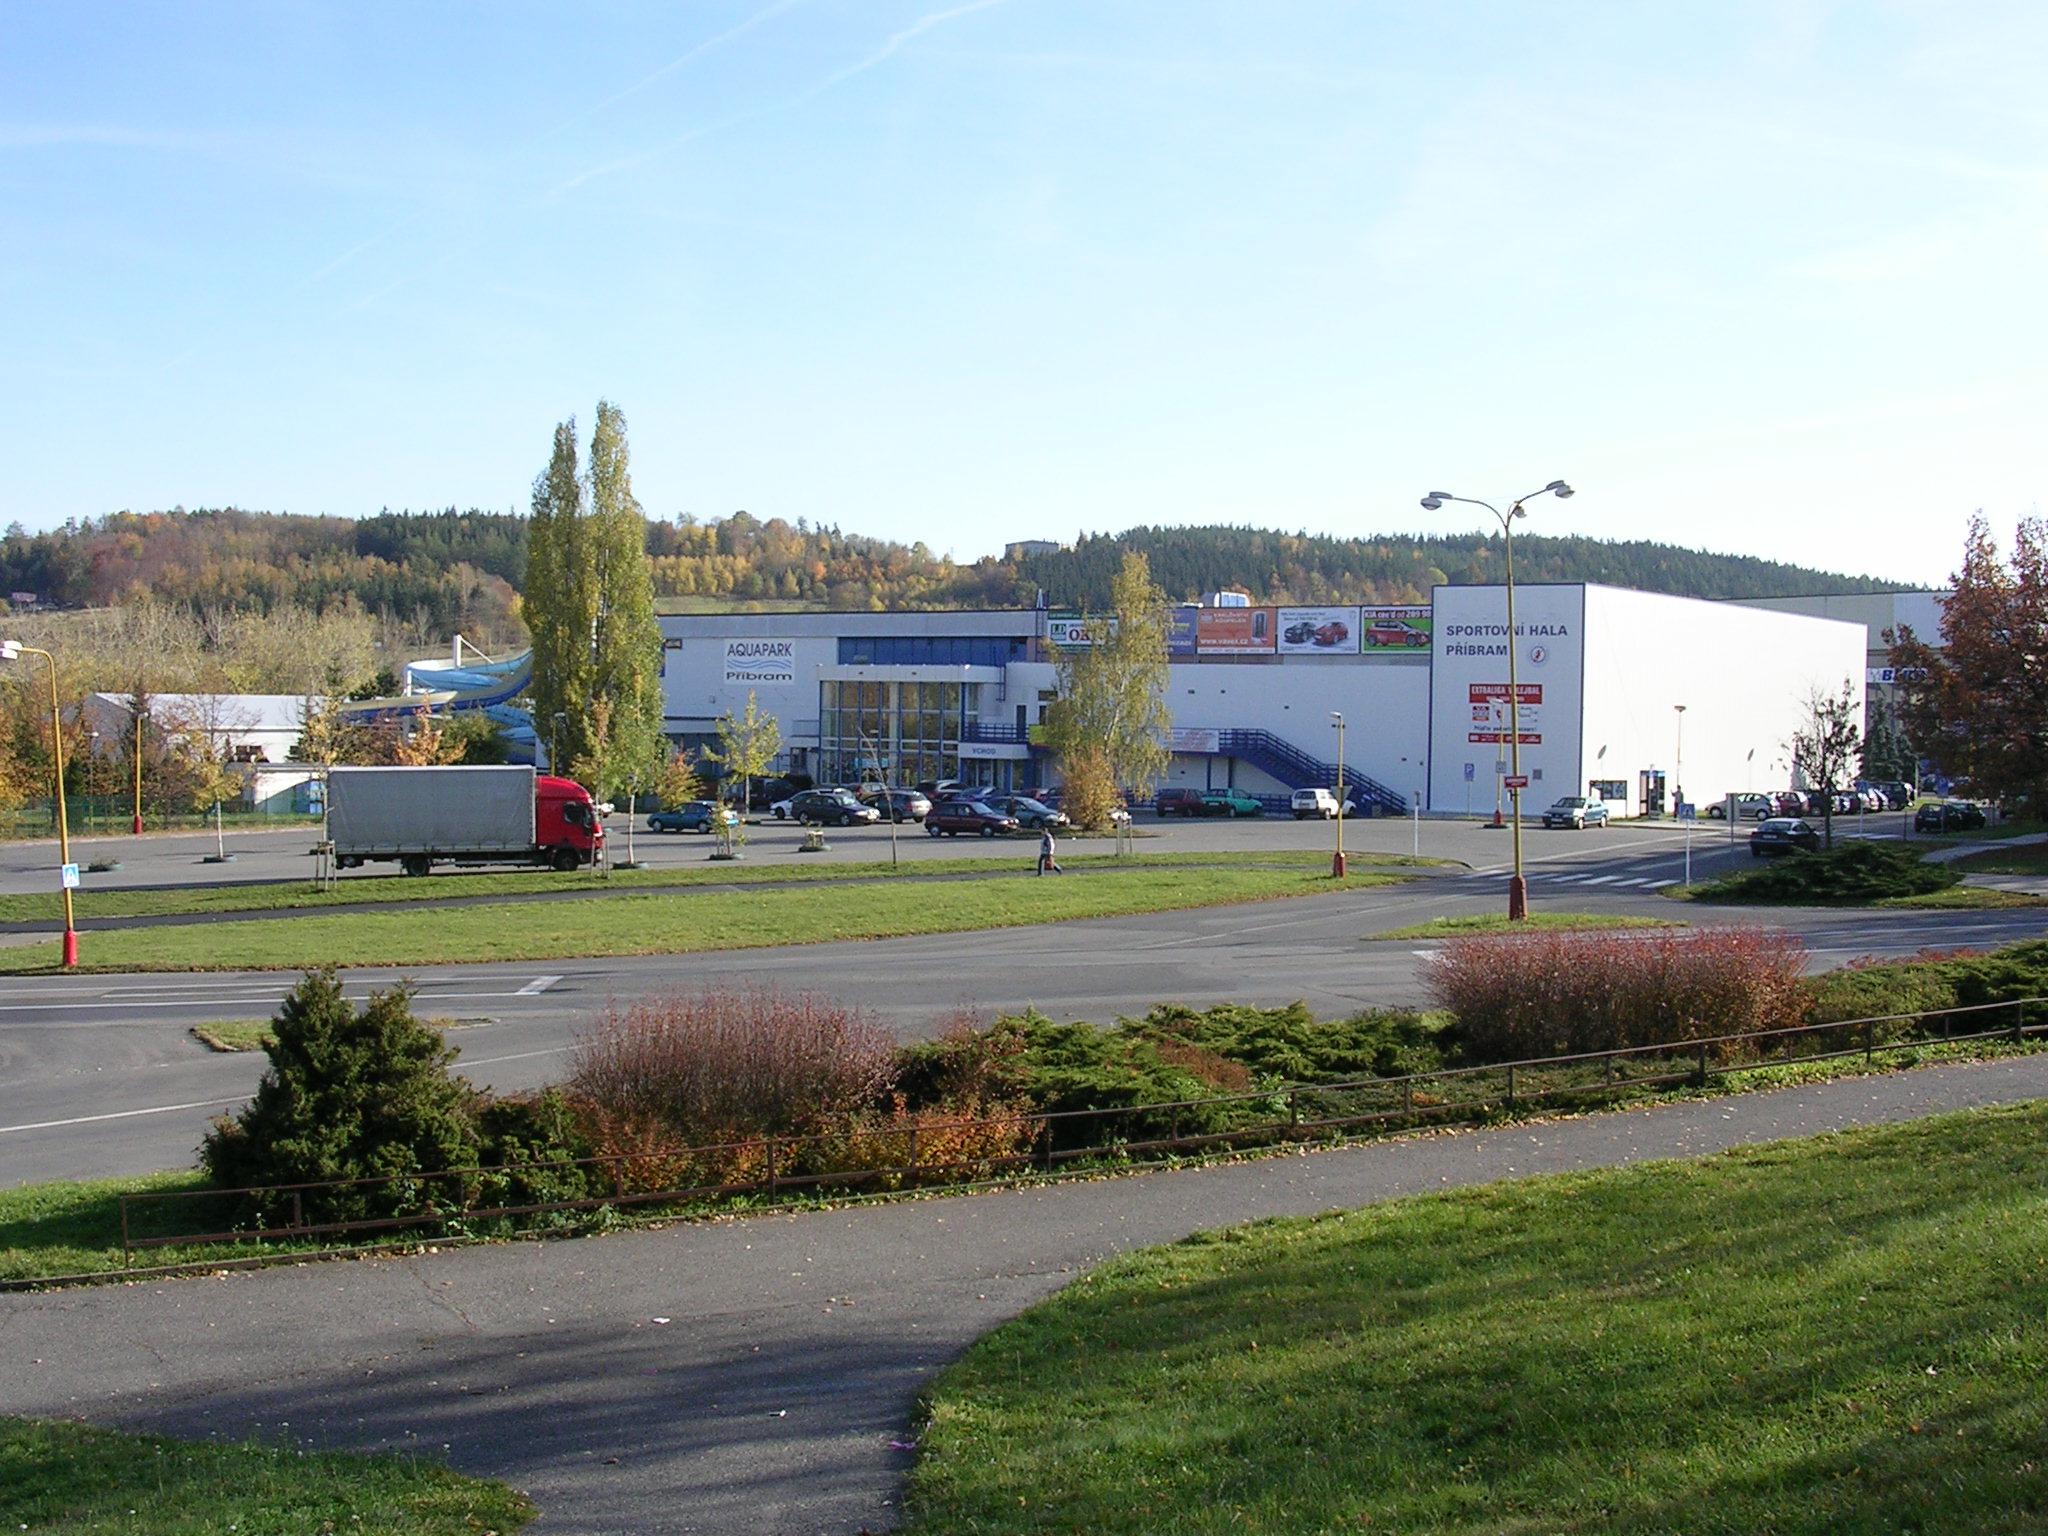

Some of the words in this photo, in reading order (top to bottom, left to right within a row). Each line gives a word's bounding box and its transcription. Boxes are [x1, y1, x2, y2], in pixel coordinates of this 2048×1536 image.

[1364, 610, 1377, 618] KIA
[1446, 622, 1525, 637] SPORTOVNÍ
[1530, 625, 1568, 637] HALA
[727, 642, 792, 657] AQUAPARK
[1446, 642, 1508, 656] PŘÍBRAM
[726, 671, 792, 681] Příbram
[1471, 685, 1506, 695] EXTRALIGA
[1507, 686, 1541, 695] VLEJBAL
[972, 747, 997, 755] VCHOD
